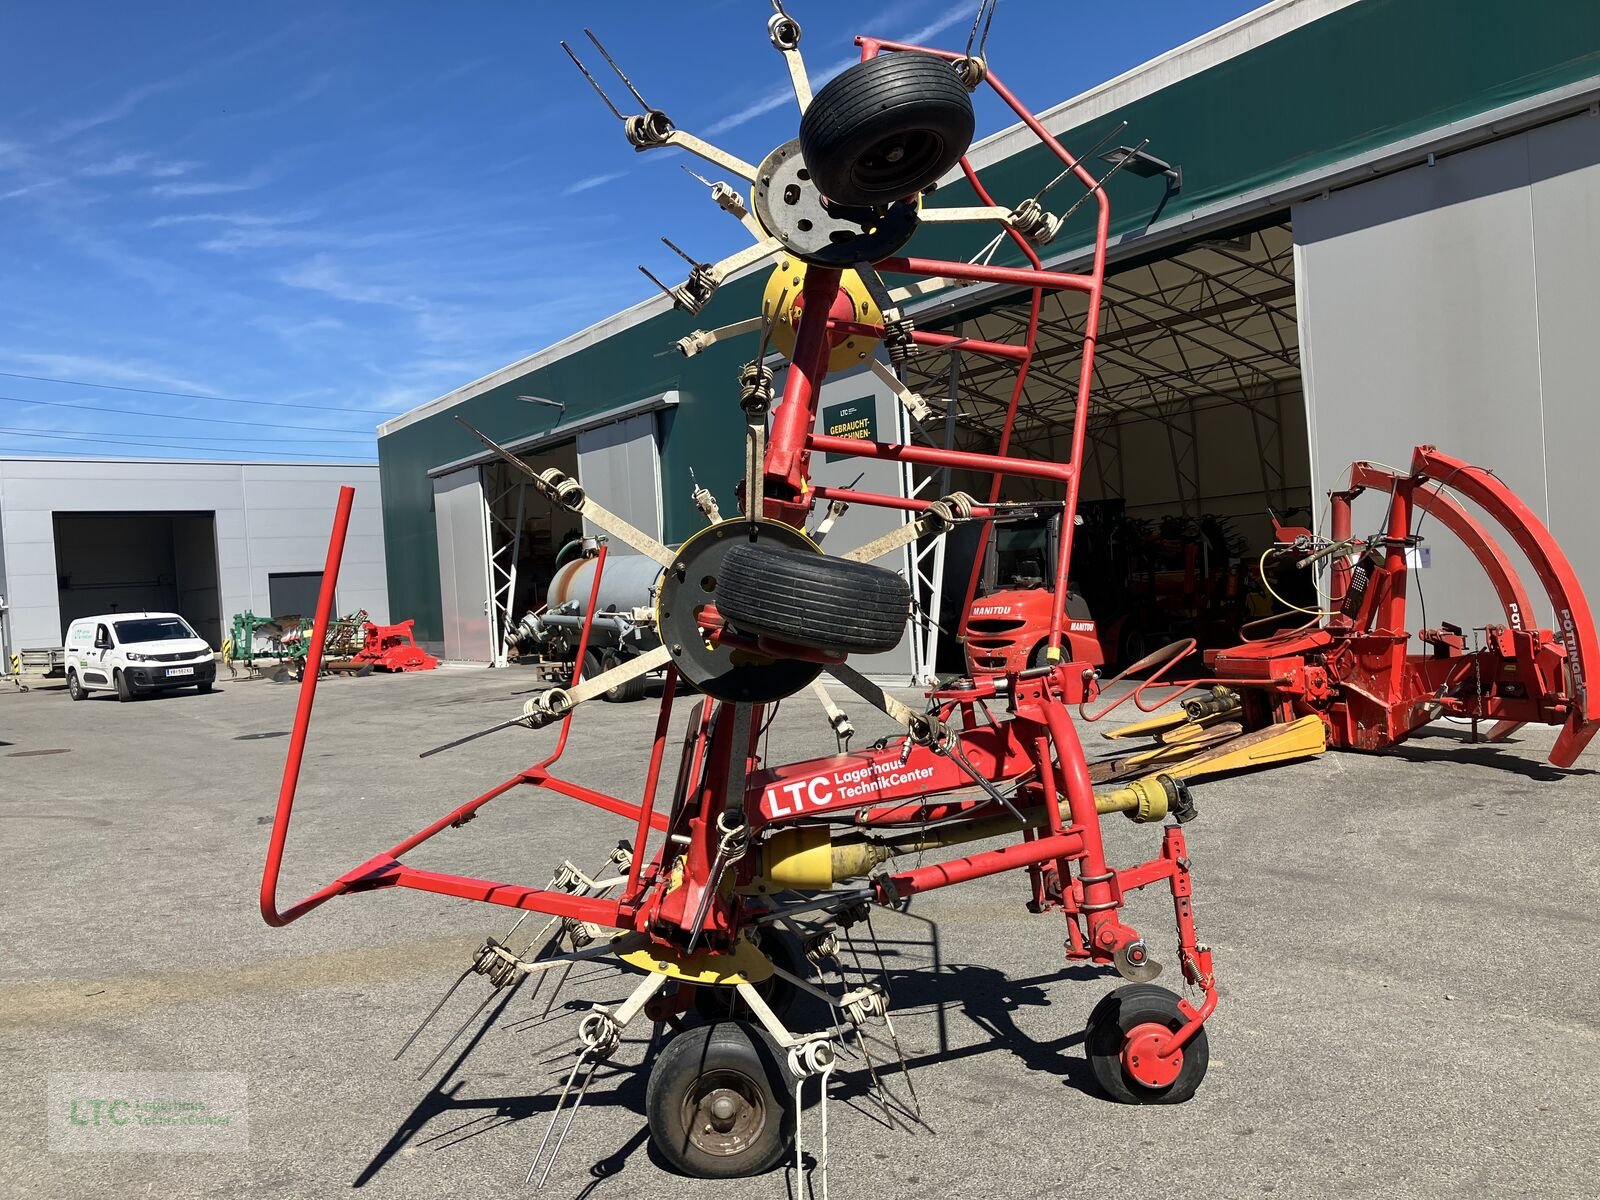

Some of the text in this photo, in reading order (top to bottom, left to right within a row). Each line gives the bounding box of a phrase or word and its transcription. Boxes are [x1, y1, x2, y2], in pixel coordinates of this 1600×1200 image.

[840, 409, 849, 417] LTC
[830, 418, 870, 435] GEBRAUCHT-
[836, 429, 871, 439] CHINEN-
[973, 606, 1011, 615] MANITOU
[1070, 622, 1095, 631] MANITOU
[834, 758, 905, 785] Lagerhaus
[837, 767, 935, 799] TechnikCenter
[767, 776, 833, 818] LTC
